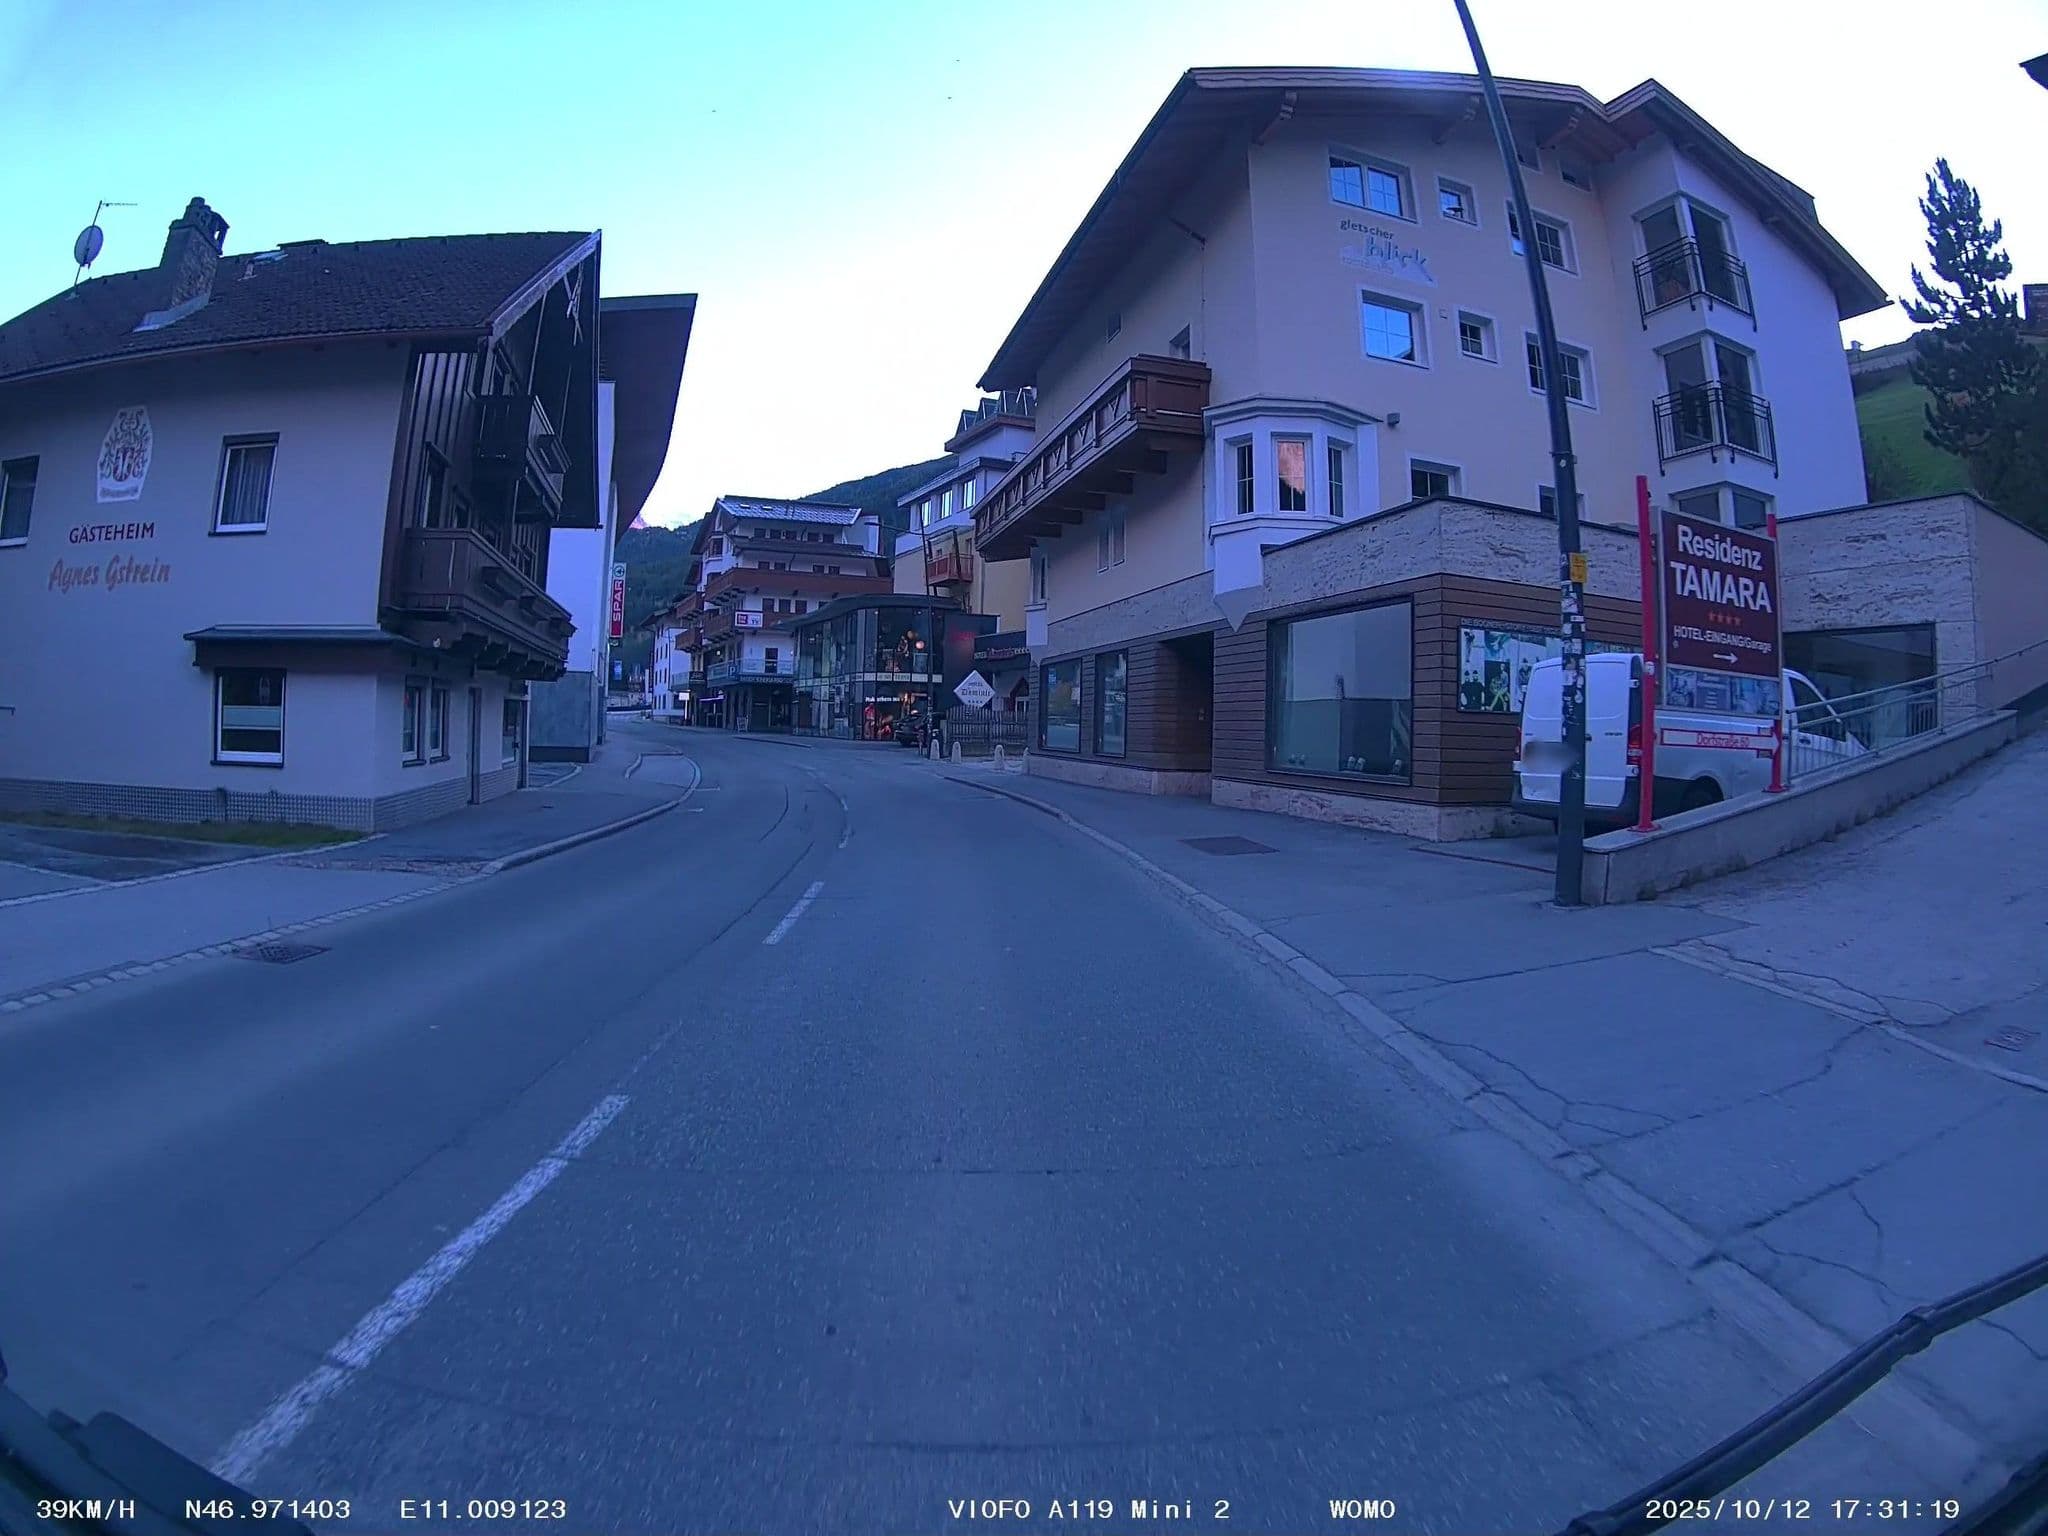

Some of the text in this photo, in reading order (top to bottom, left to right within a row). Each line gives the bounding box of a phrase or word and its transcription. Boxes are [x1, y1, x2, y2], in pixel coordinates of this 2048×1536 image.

[1340, 219, 1395, 240] gletscher
[69, 522, 155, 544] GÄSTEHEIM
[1677, 524, 1763, 571] Residenz
[48, 553, 171, 595] Agnes Gstrein
[1670, 561, 1773, 613] TAMARA
[613, 580, 623, 622] SPAR
